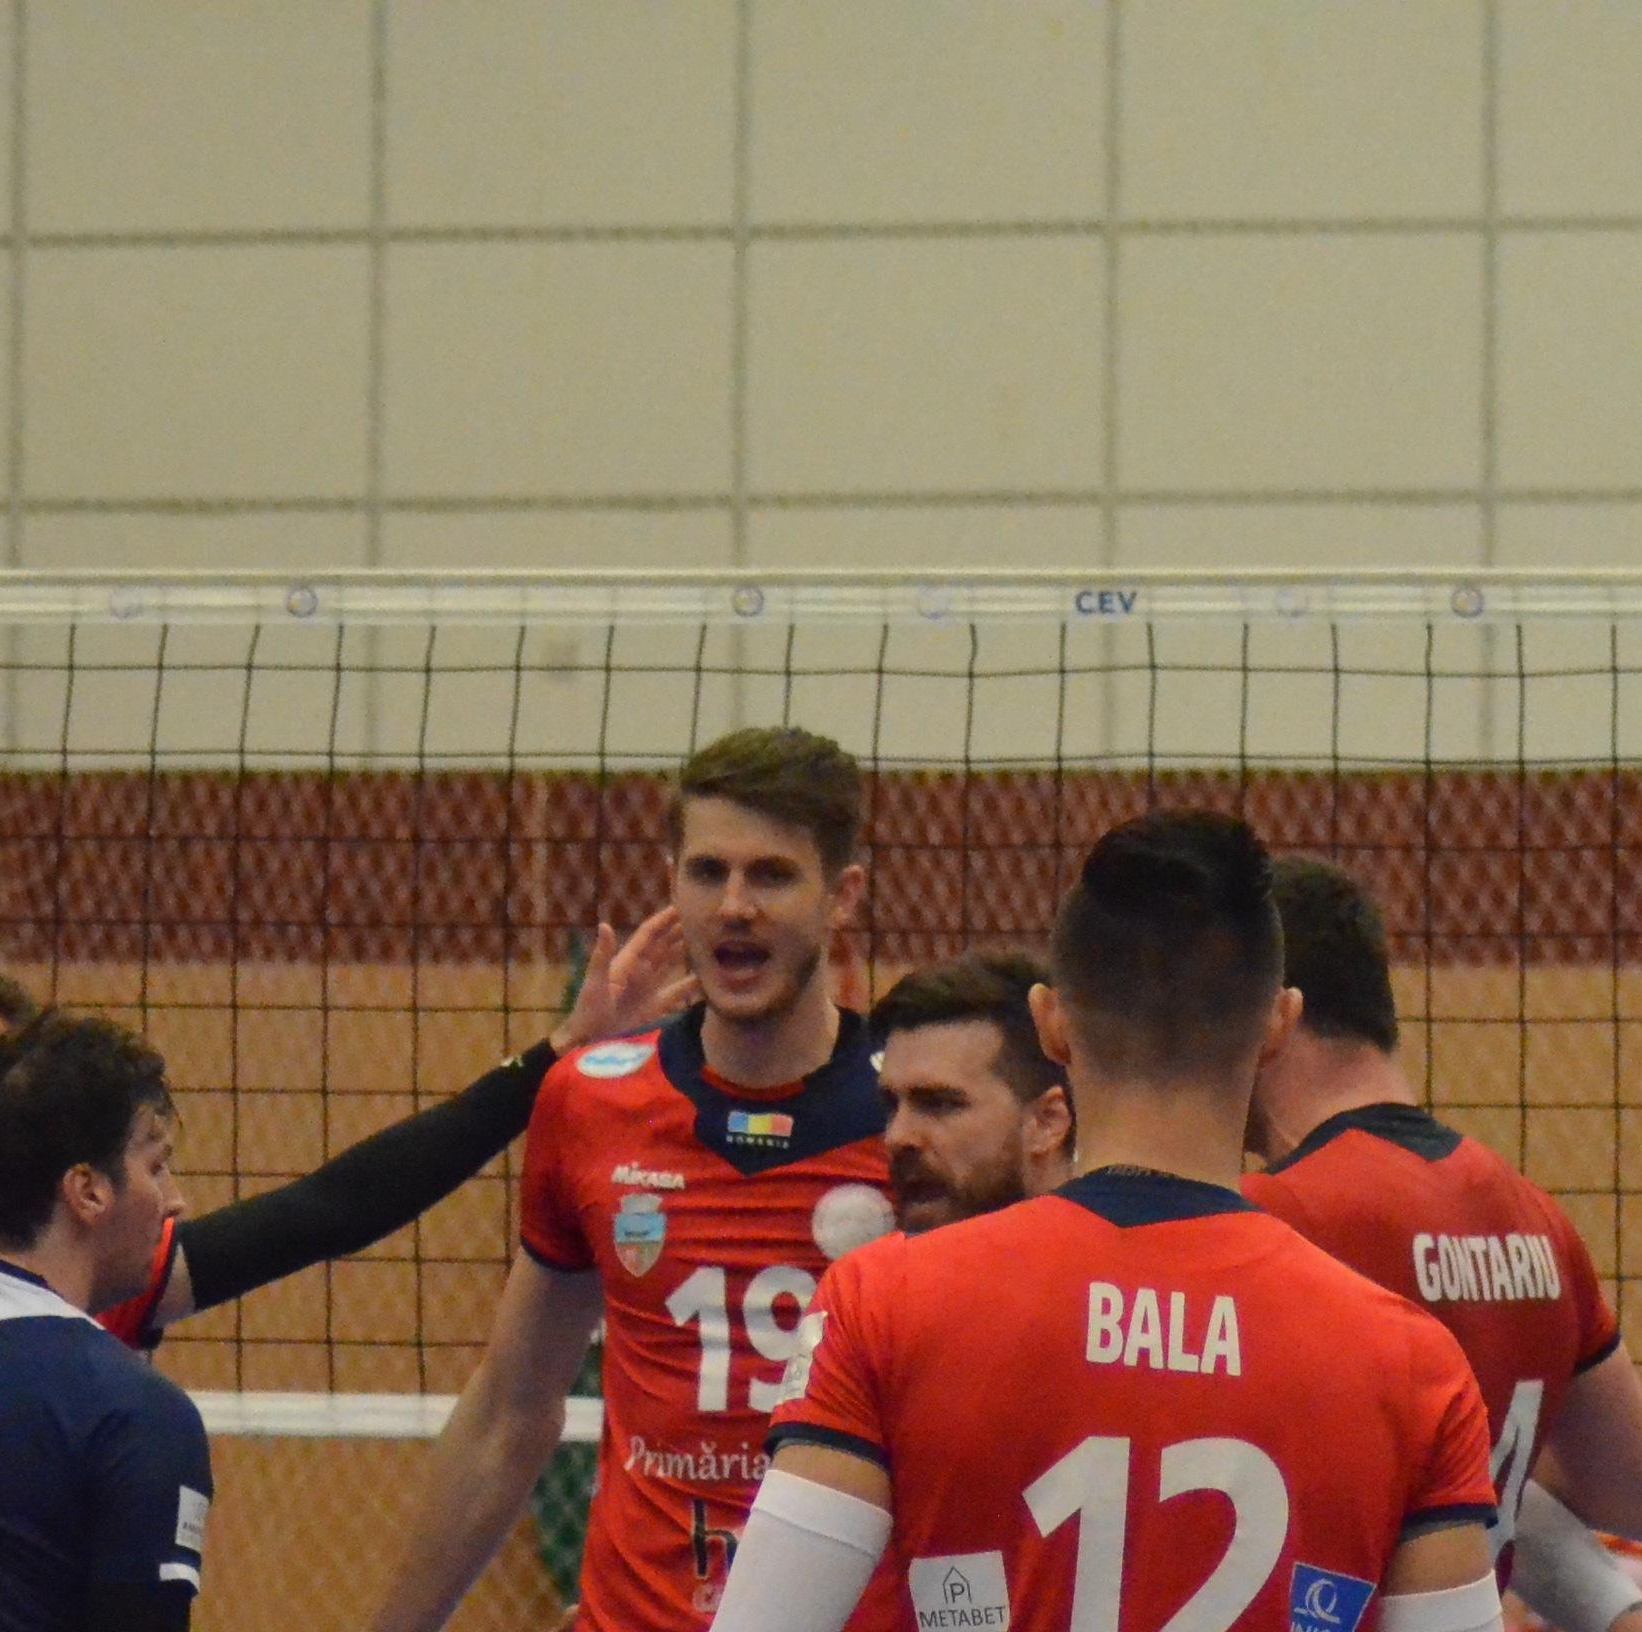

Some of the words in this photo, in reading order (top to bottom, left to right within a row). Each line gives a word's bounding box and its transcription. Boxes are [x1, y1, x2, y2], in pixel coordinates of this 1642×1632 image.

[1075, 590, 1137, 614] CEV
[664, 1264, 823, 1414] 19
[1086, 1281, 1241, 1376] BALA
[919, 1605, 1006, 1628] METABET
